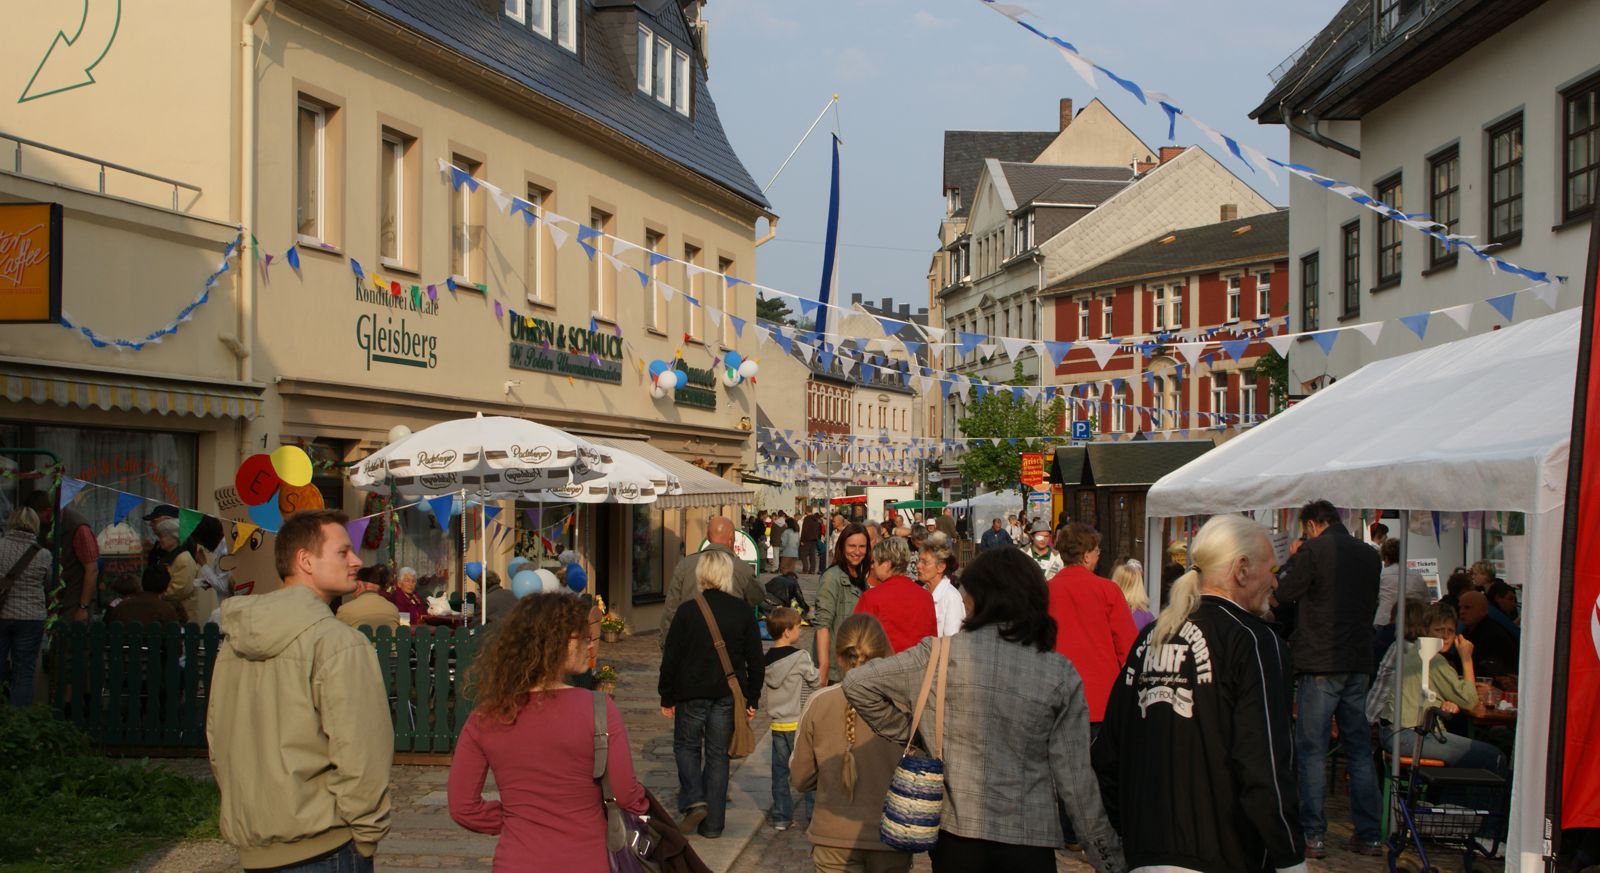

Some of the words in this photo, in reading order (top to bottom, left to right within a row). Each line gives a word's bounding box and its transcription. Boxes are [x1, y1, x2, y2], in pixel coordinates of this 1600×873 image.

[357, 313, 438, 371] Gleisberg
[556, 324, 566, 349] &
[568, 326, 624, 360] SCHMUCK
[1076, 423, 1086, 437] P
[250, 469, 272, 495] E
[282, 492, 299, 513] S
